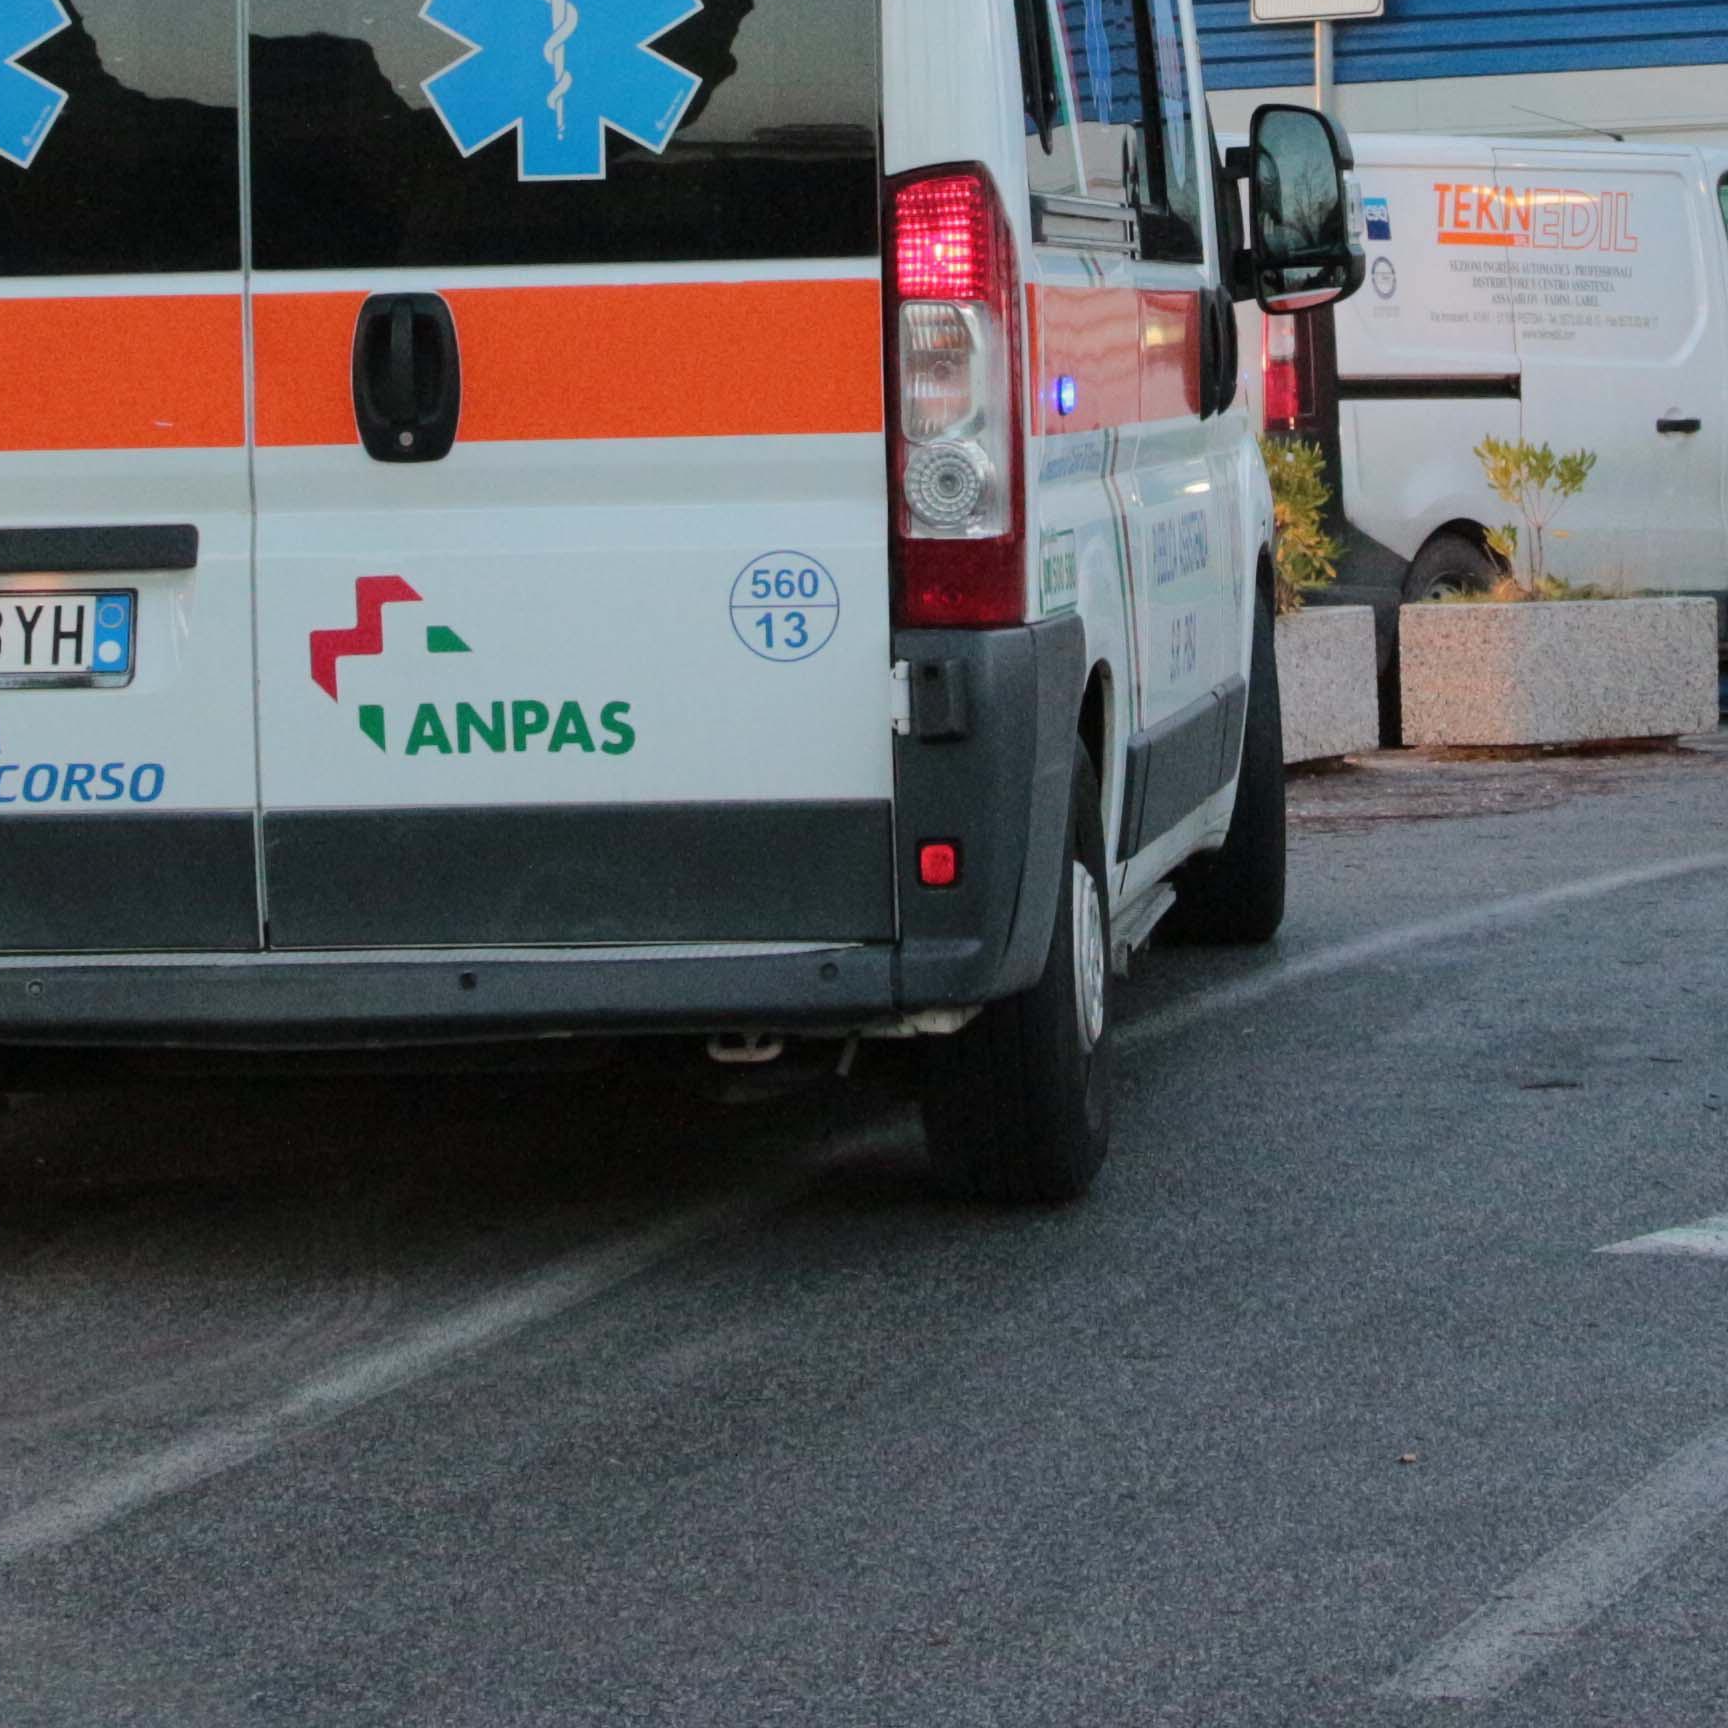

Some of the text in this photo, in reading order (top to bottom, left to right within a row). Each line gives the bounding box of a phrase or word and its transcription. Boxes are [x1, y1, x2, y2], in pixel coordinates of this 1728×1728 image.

[751, 568, 819, 599] 560
[755, 611, 809, 648] 13
[404, 699, 637, 757] ANPAS
